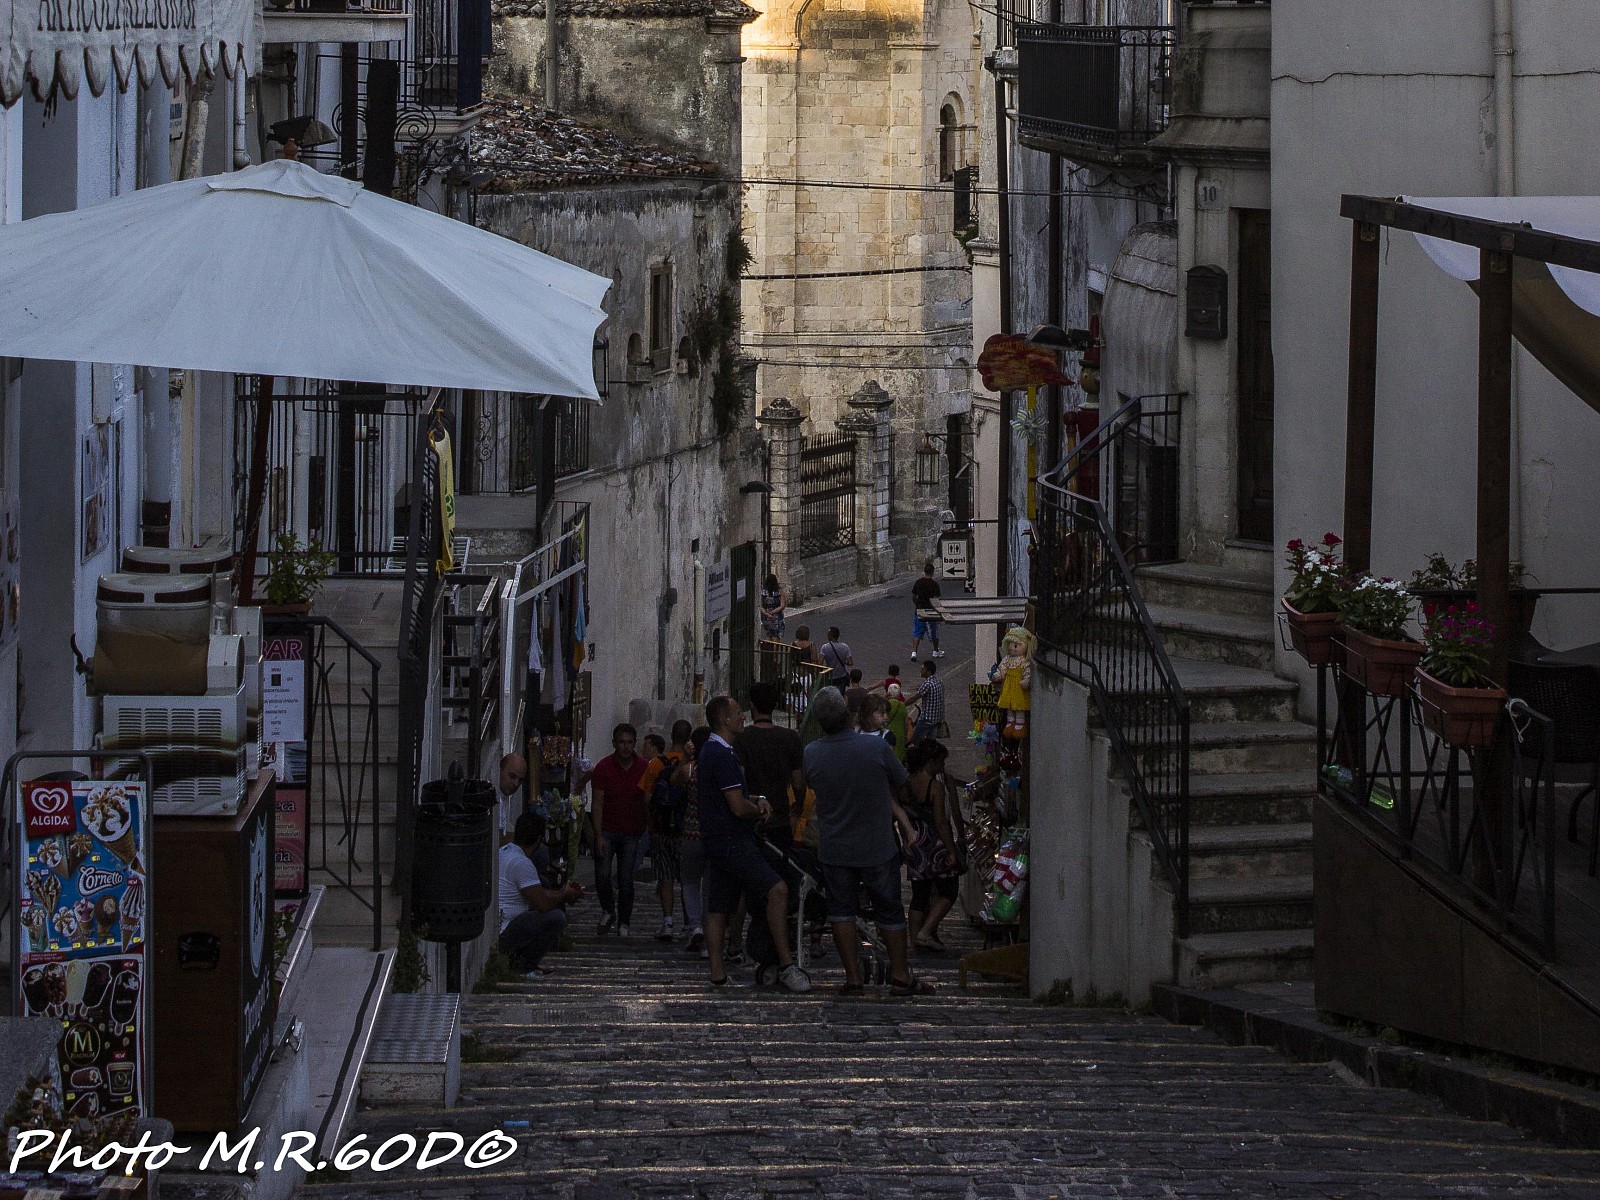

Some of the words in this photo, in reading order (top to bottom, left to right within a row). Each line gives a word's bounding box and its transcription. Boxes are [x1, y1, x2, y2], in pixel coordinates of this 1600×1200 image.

[1202, 186, 1217, 202] 10
[943, 557, 966, 565] bagni
[969, 683, 997, 695] PANE
[30, 815, 70, 827] ALGIDA
[78, 866, 124, 896] Cornetto
